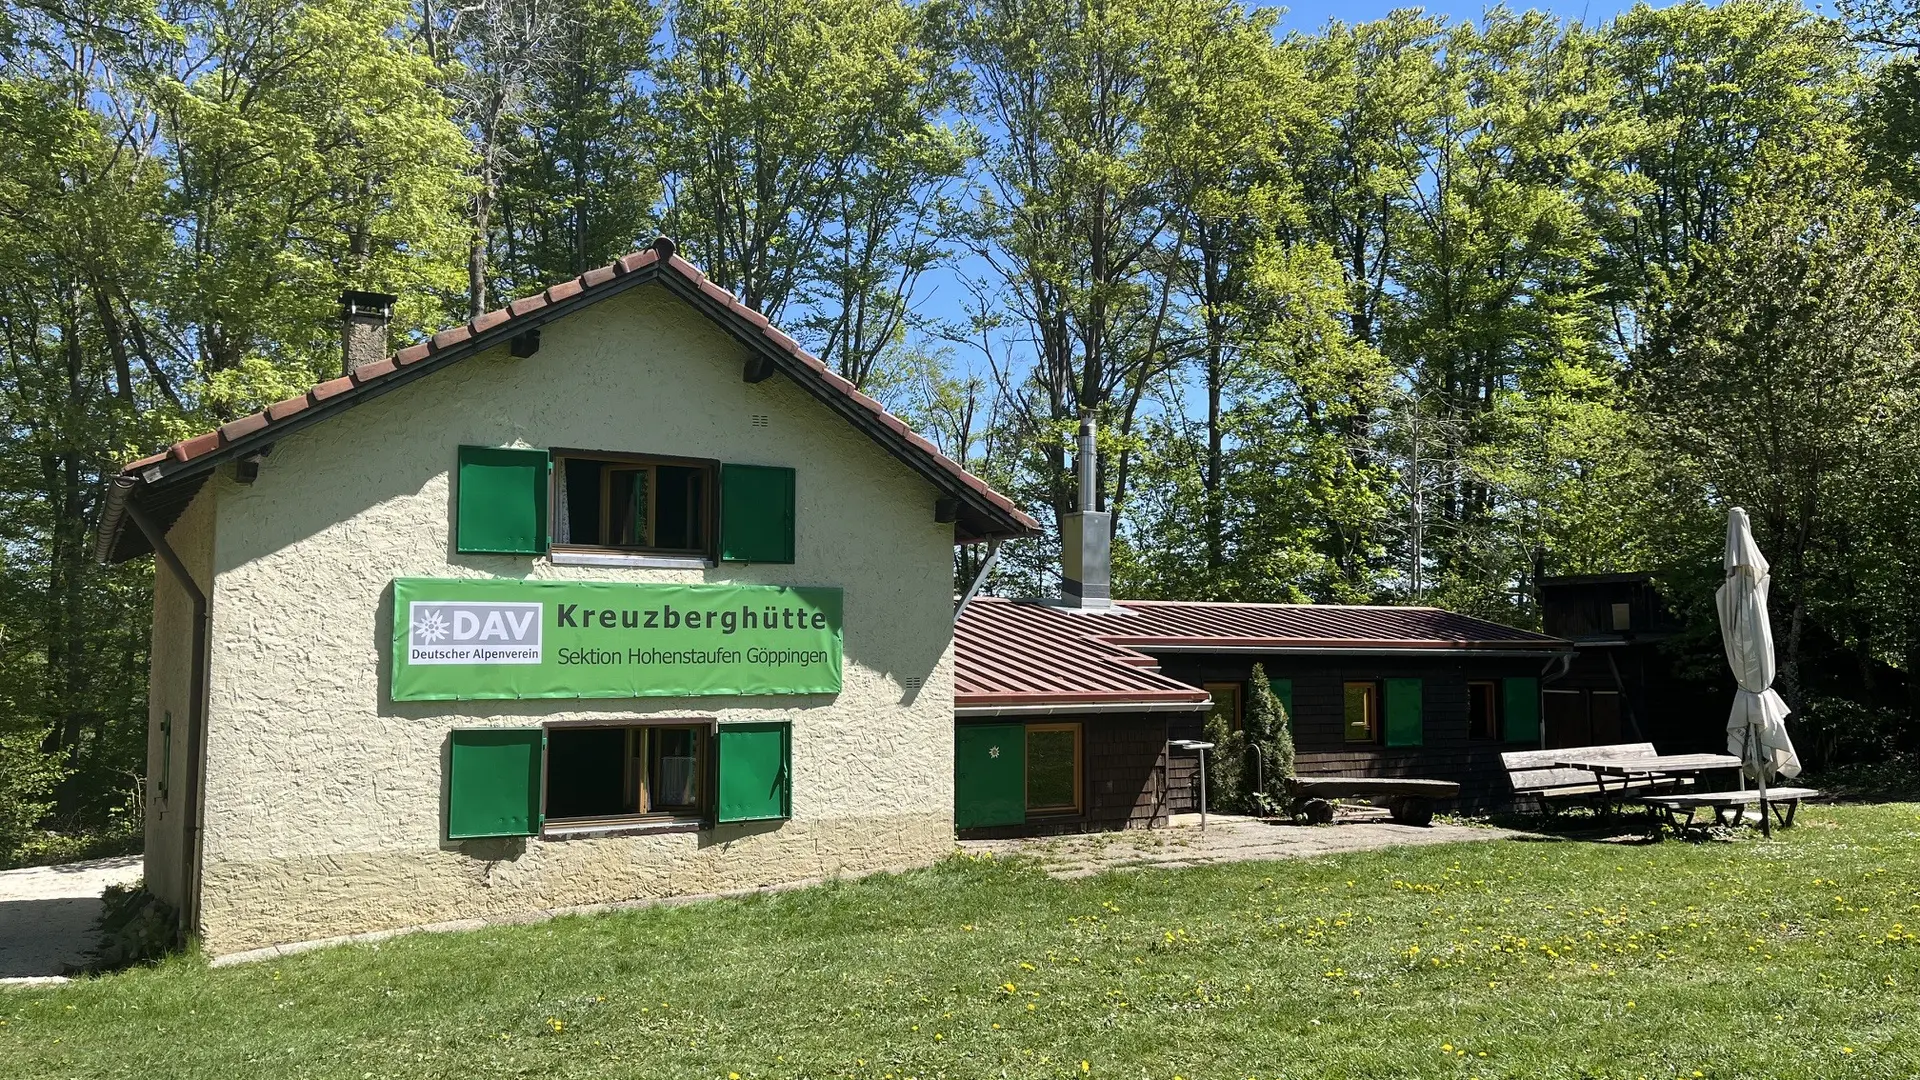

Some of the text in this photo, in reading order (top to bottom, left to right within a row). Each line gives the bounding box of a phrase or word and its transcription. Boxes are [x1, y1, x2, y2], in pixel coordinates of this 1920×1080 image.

[453, 611, 534, 640] DAV
[557, 603, 826, 635] Kreuzberghütte
[412, 648, 539, 661] Deutscher Alpenverein
[558, 647, 827, 667] Sektion Hohenstaufen Göppingen
